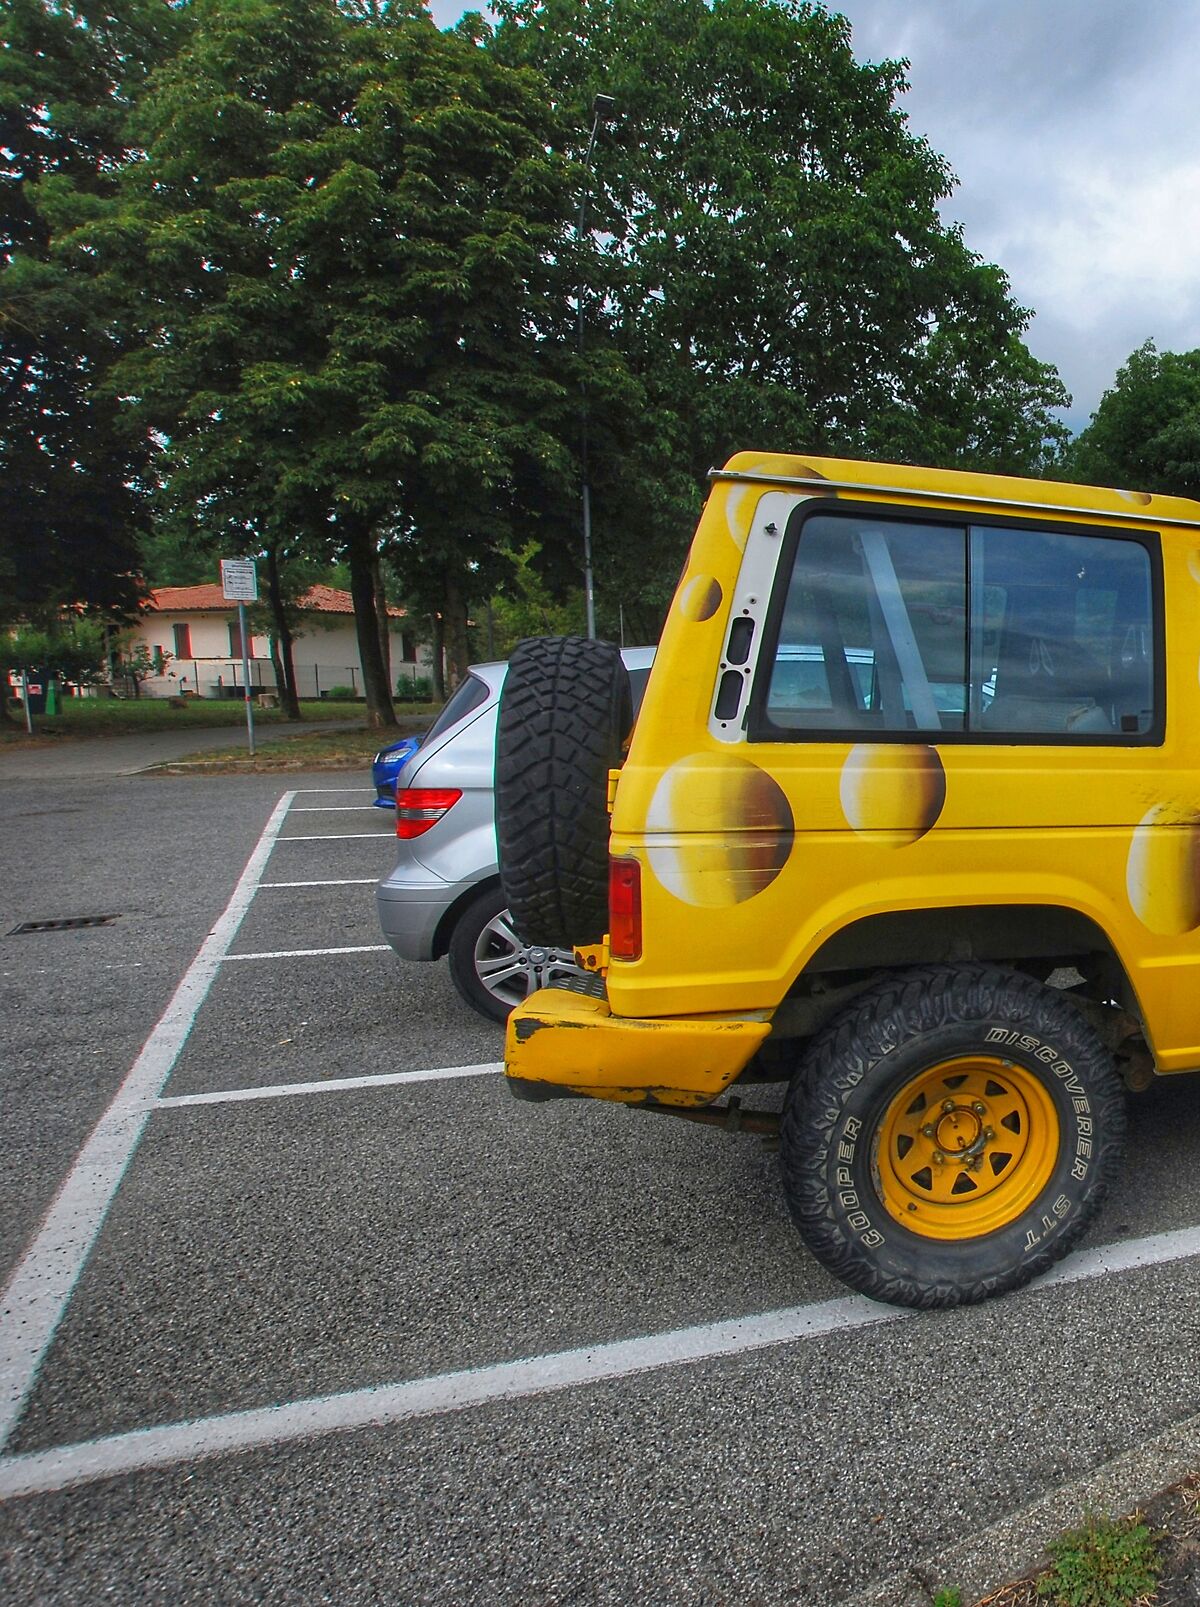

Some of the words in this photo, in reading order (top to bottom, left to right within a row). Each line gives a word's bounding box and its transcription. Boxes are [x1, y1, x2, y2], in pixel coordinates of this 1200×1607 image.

[984, 1028, 1093, 1181] DISCOVERER
[837, 1116, 886, 1249] COOPER
[1024, 1194, 1072, 1251] STT
